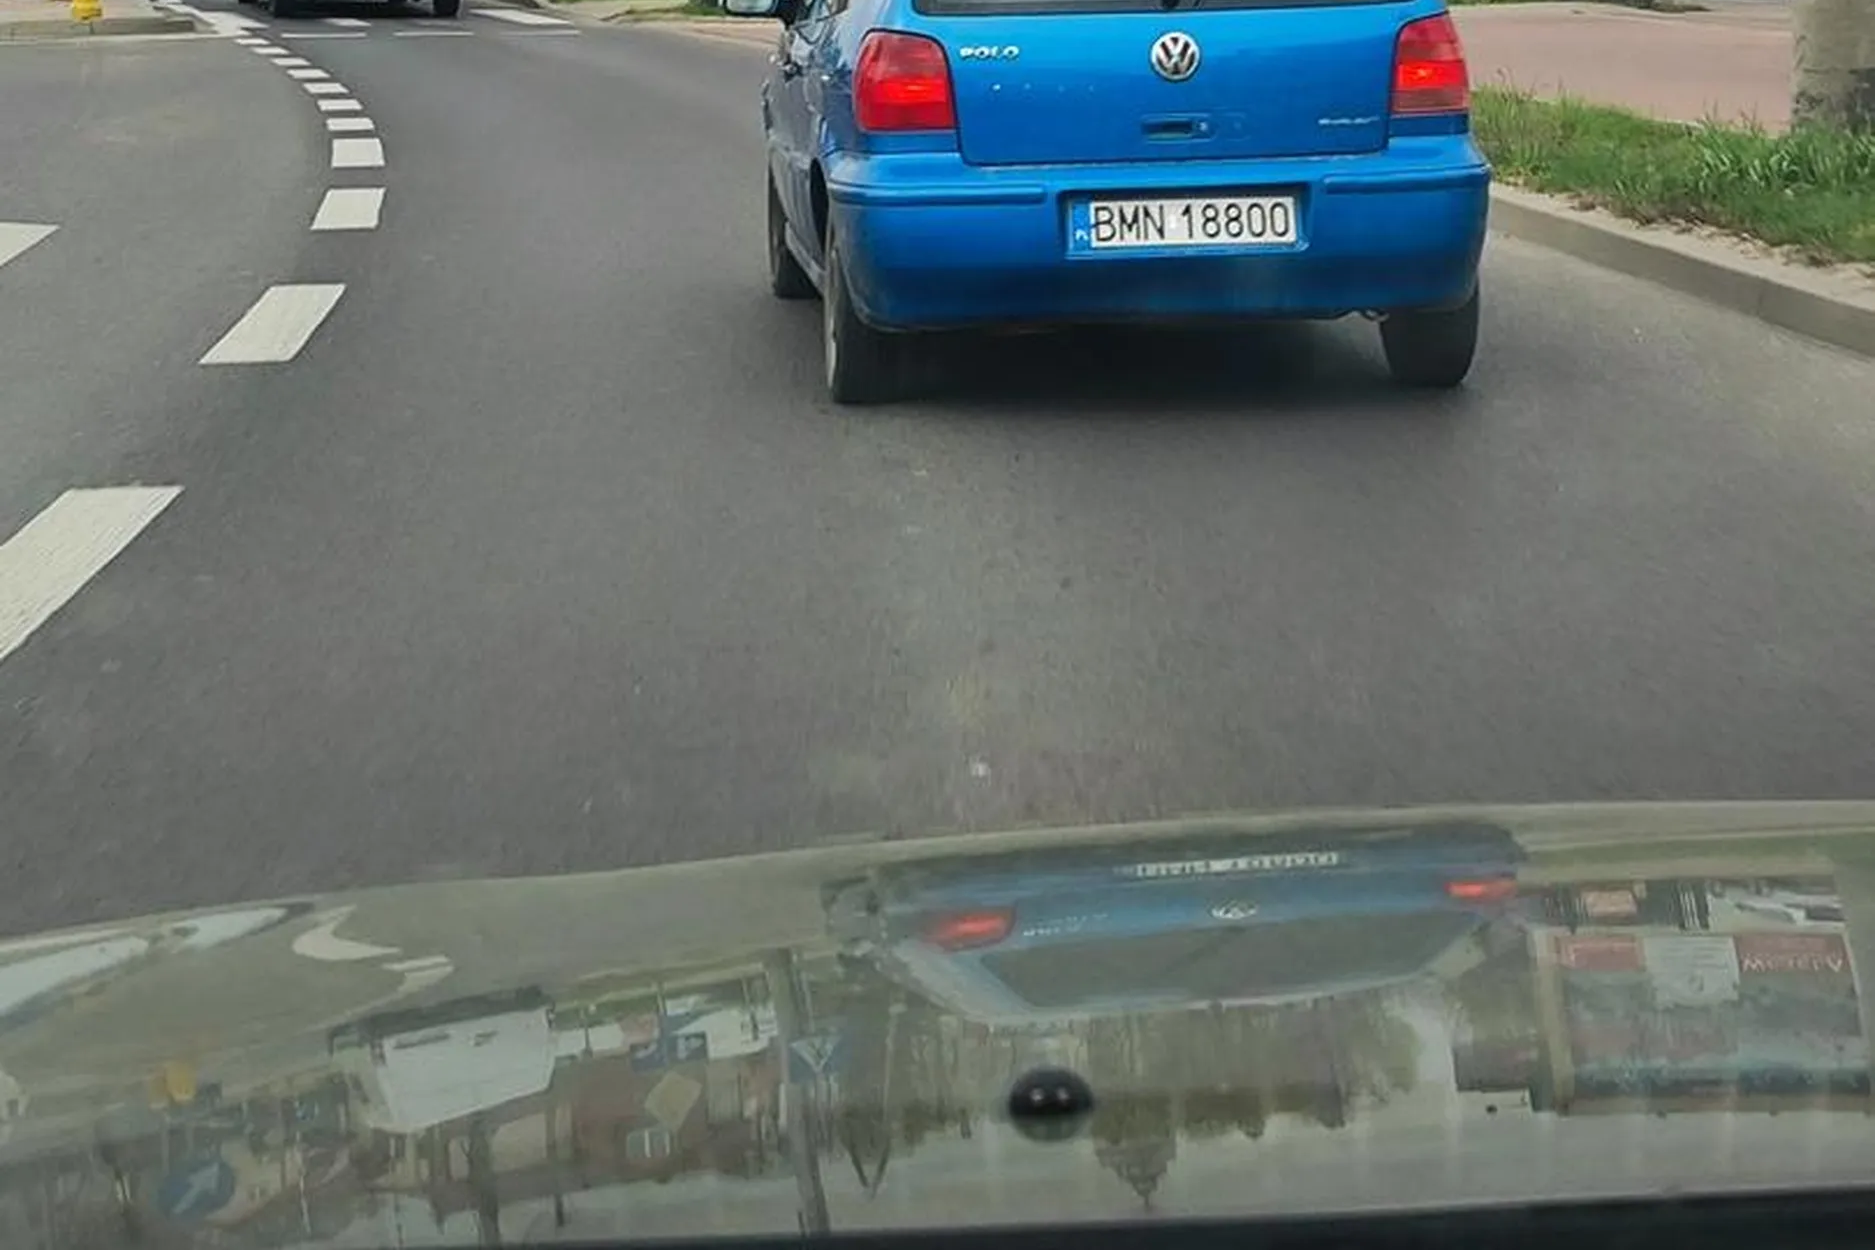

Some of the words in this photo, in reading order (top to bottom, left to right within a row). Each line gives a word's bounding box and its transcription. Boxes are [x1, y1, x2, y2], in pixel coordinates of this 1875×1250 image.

[960, 45, 1020, 59] POLO
[1094, 204, 1165, 241] BMN
[1181, 202, 1290, 239] 18800
